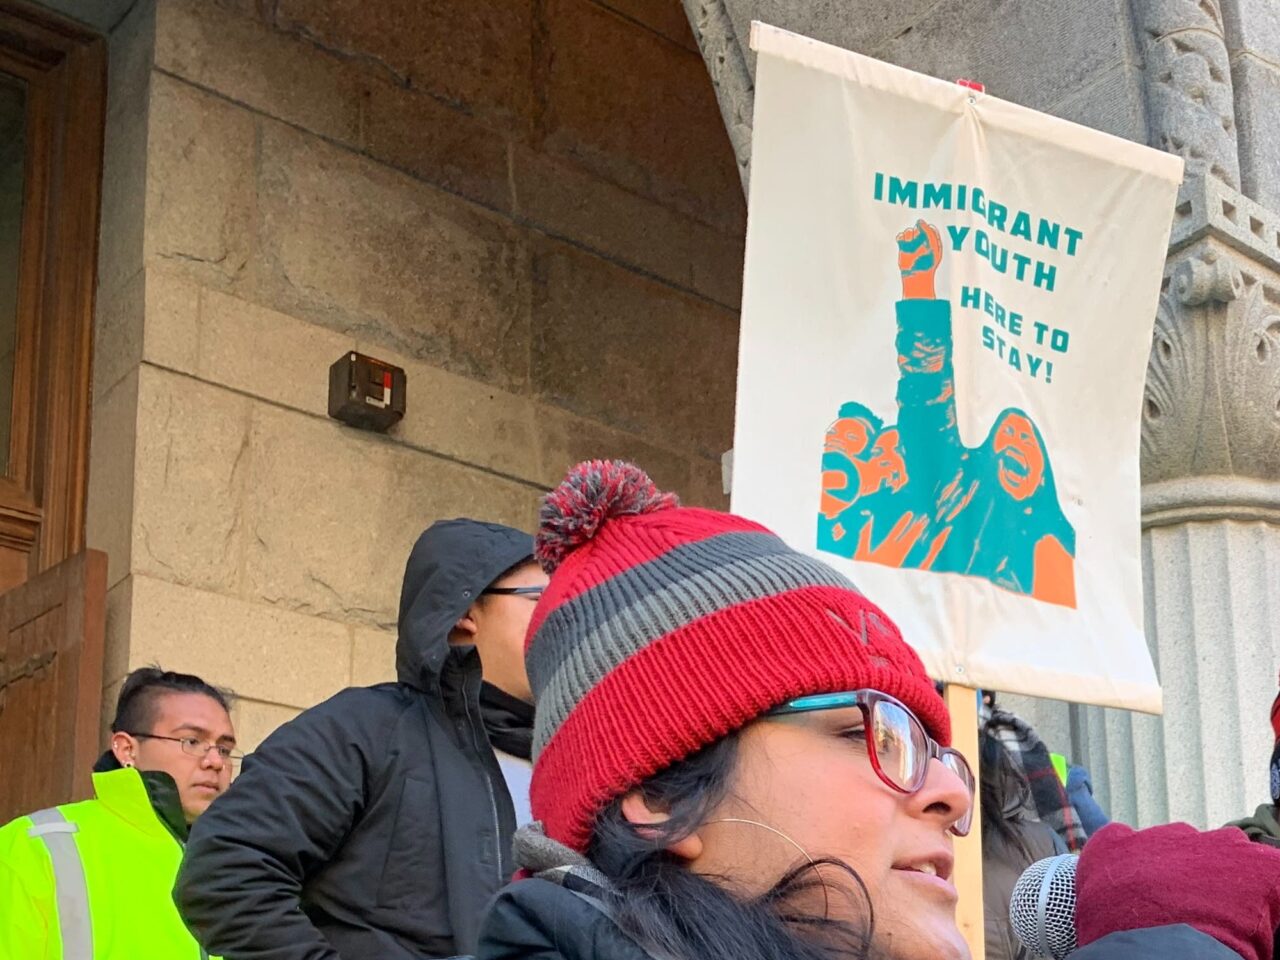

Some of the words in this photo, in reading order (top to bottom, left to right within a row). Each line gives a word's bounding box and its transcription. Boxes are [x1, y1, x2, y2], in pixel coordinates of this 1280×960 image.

[873, 172, 1083, 256] IMMIGRANT
[947, 225, 1057, 292] YOUTH
[960, 286, 1022, 336] HERE
[1034, 321, 1070, 353] TO
[982, 326, 1053, 384] STAY!
